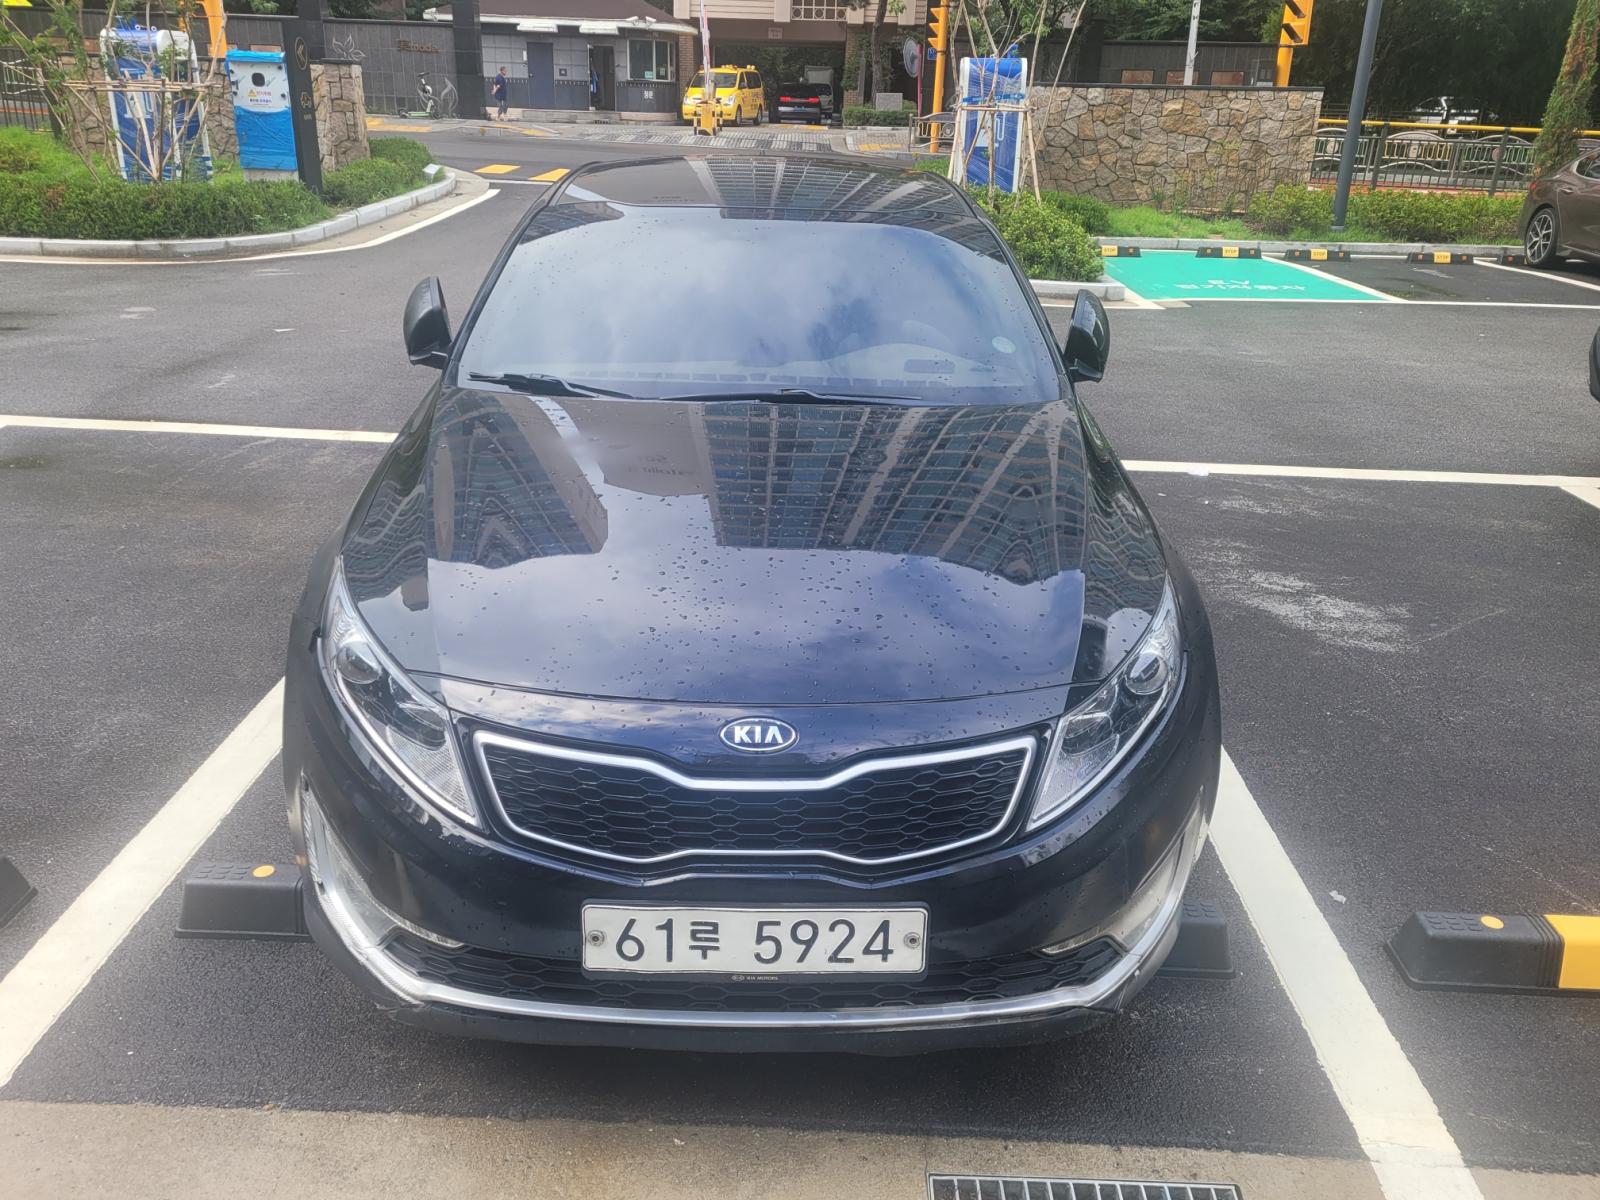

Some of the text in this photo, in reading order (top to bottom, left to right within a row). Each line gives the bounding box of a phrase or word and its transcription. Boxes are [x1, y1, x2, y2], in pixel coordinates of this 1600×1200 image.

[734, 725, 784, 744] KIA
[615, 918, 894, 964] 61루 5924
